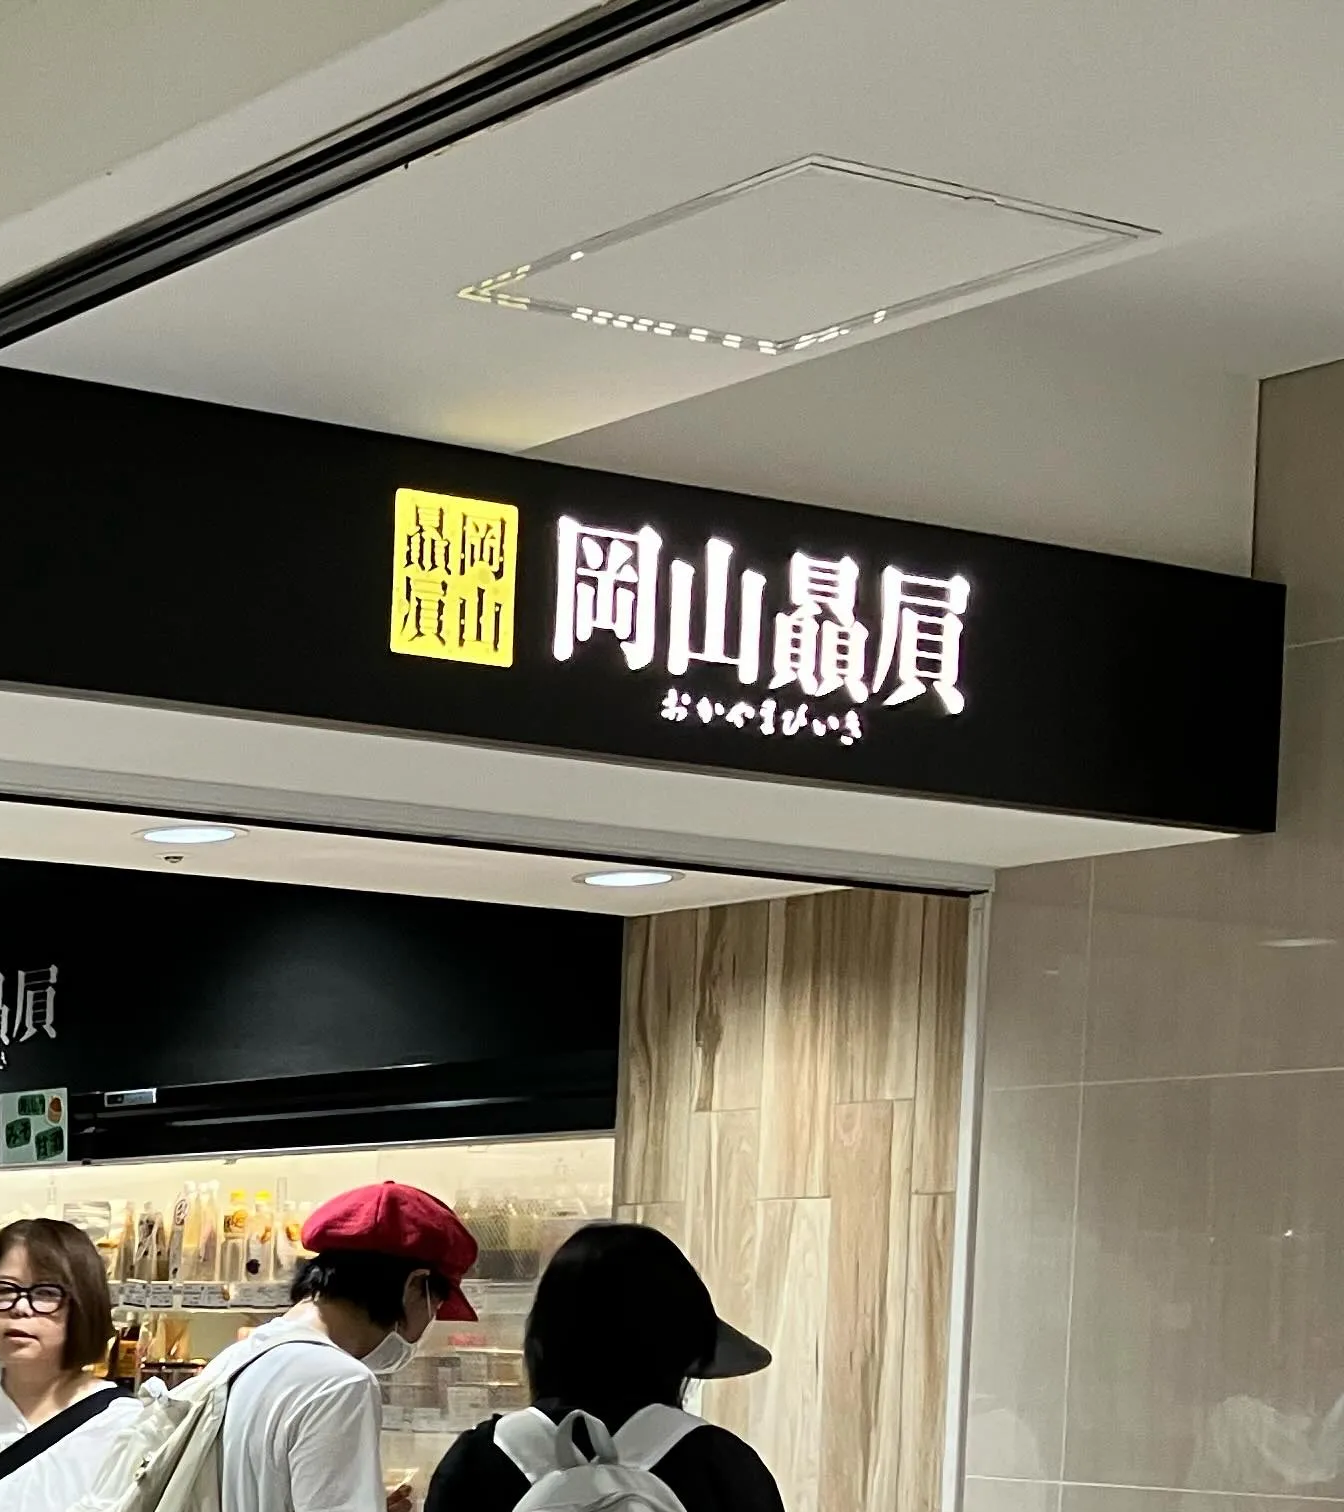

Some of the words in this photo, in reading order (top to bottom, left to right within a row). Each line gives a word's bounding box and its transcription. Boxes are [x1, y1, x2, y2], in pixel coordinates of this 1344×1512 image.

[552, 514, 971, 716] 岡山贔屓
[661, 687, 864, 746] おかやまびいき
